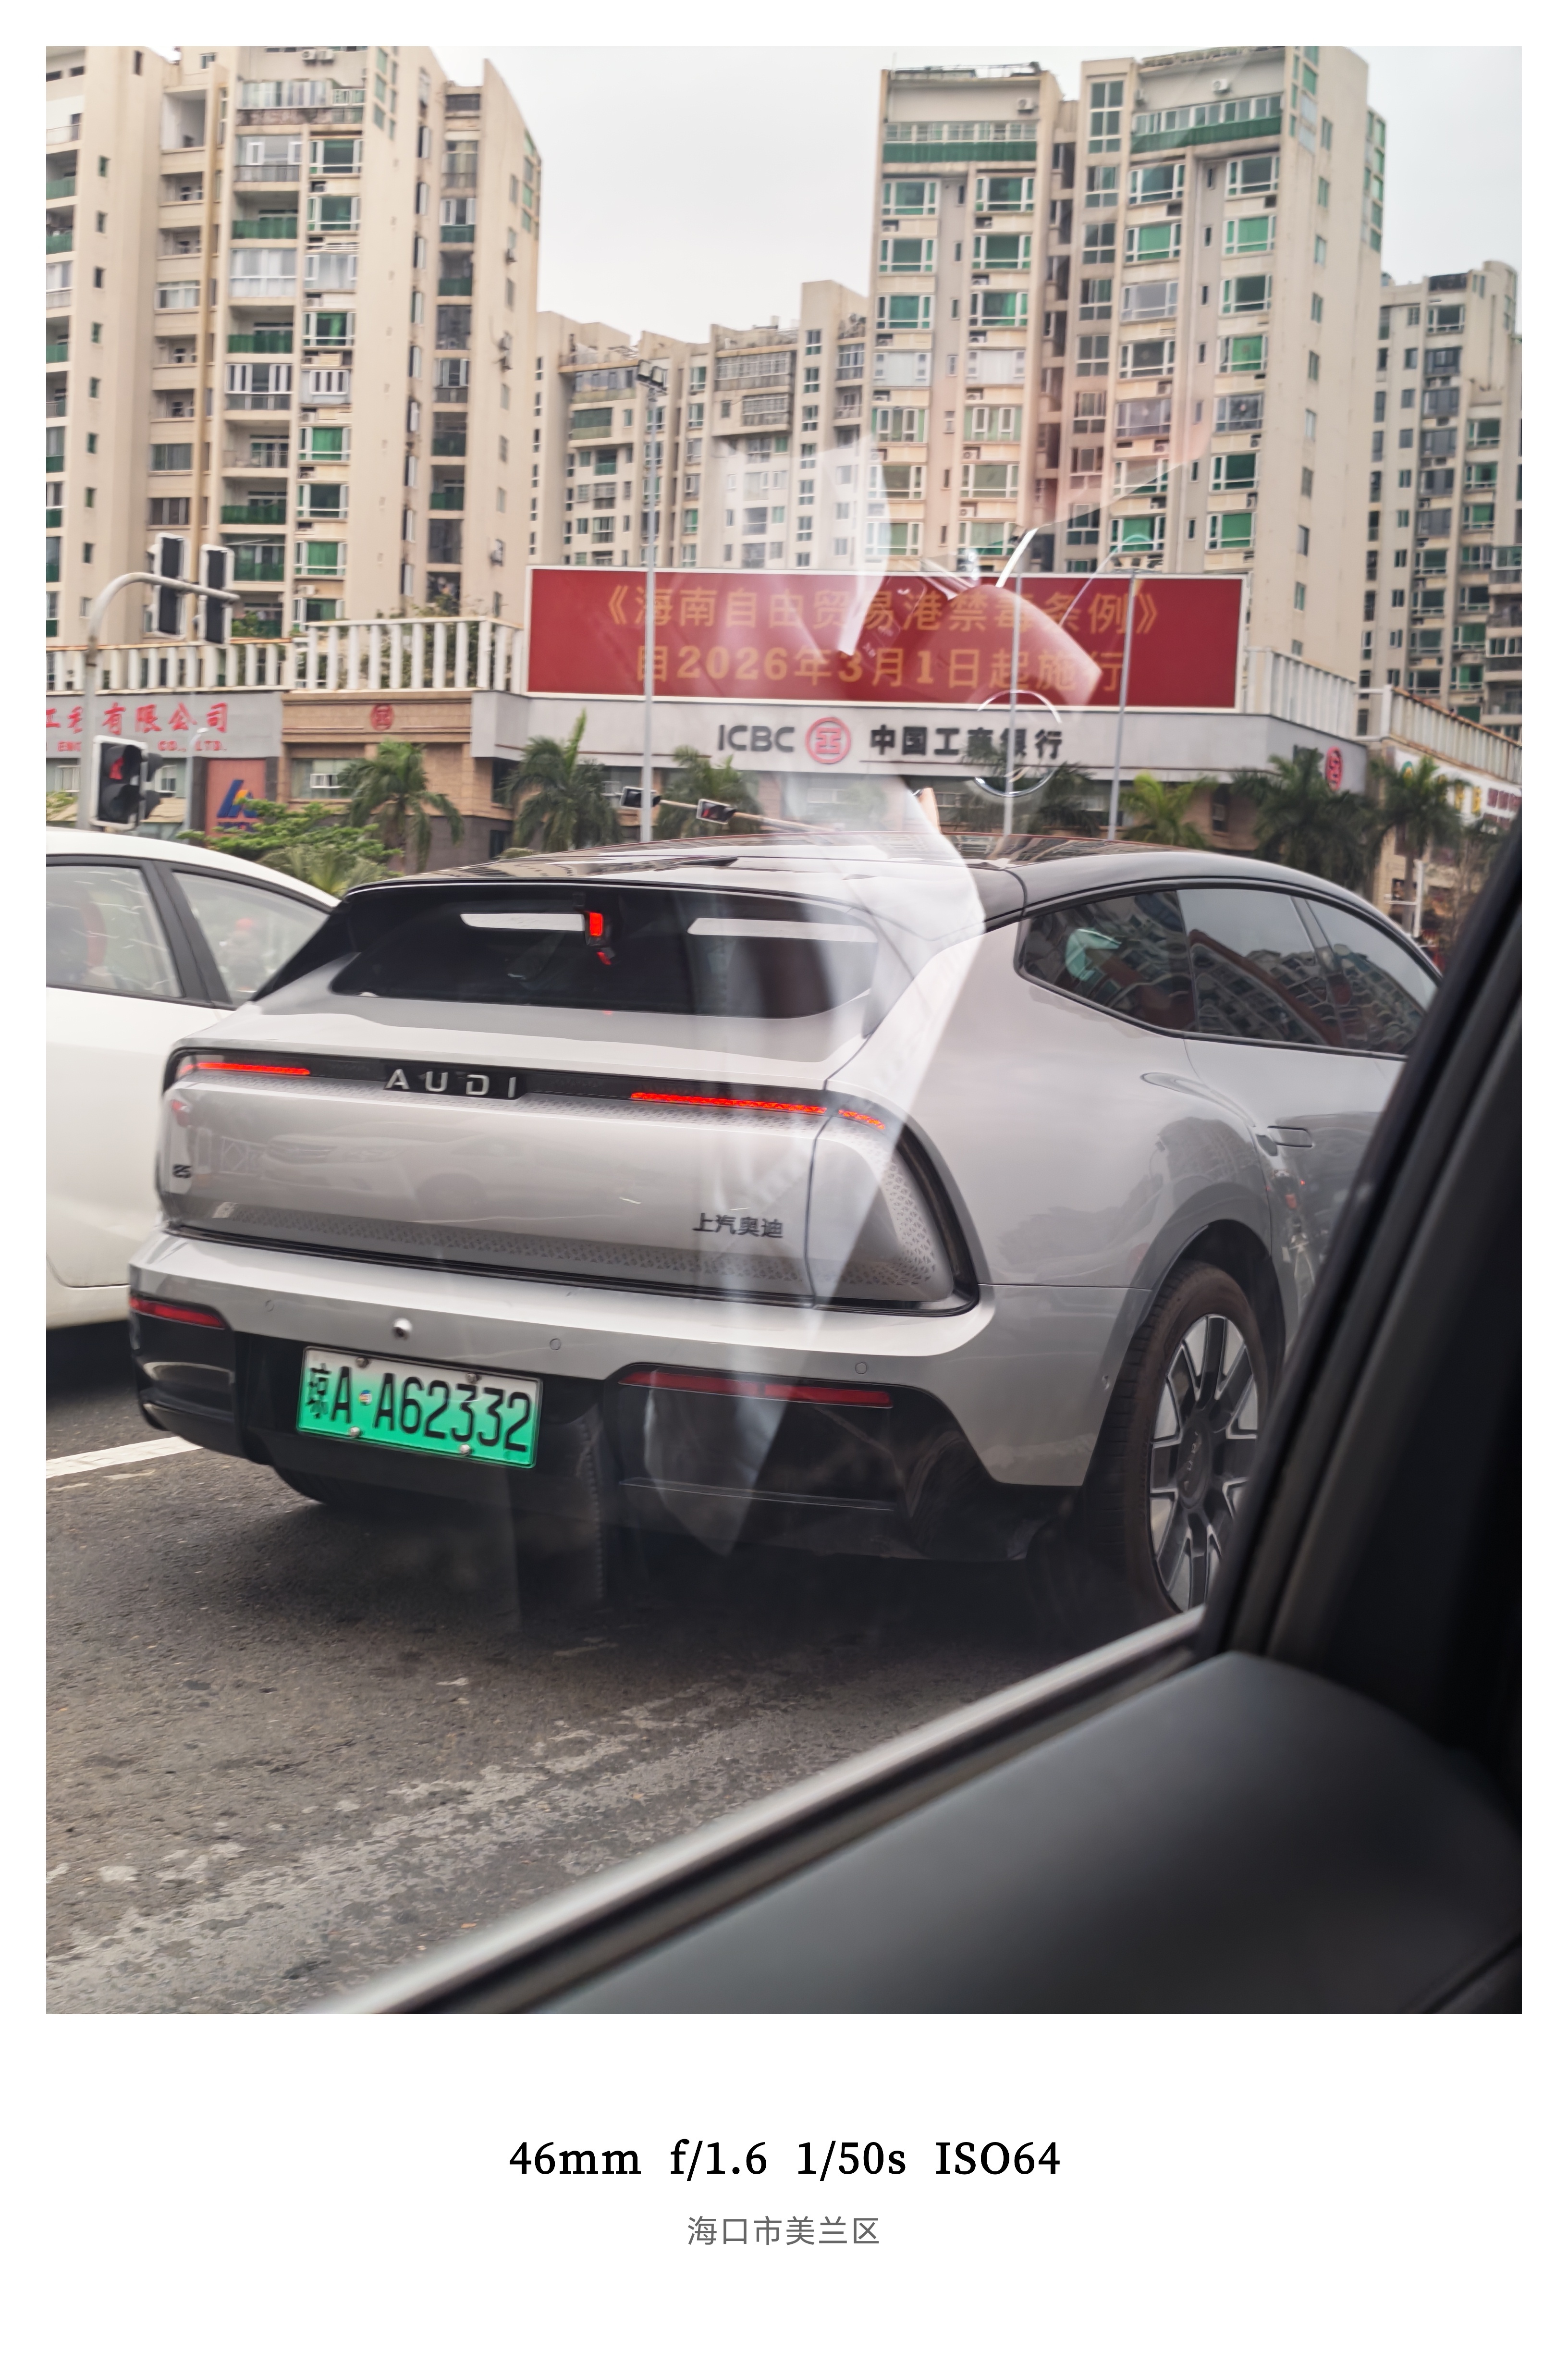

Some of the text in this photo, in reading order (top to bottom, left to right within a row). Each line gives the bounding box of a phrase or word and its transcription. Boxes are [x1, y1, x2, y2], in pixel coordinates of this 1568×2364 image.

[637, 644, 1123, 691] 自2026年3月1日起施行
[718, 725, 795, 752] ICBC
[383, 1069, 516, 1098] AUDI
[692, 1212, 783, 1238] 上汽奥迪
